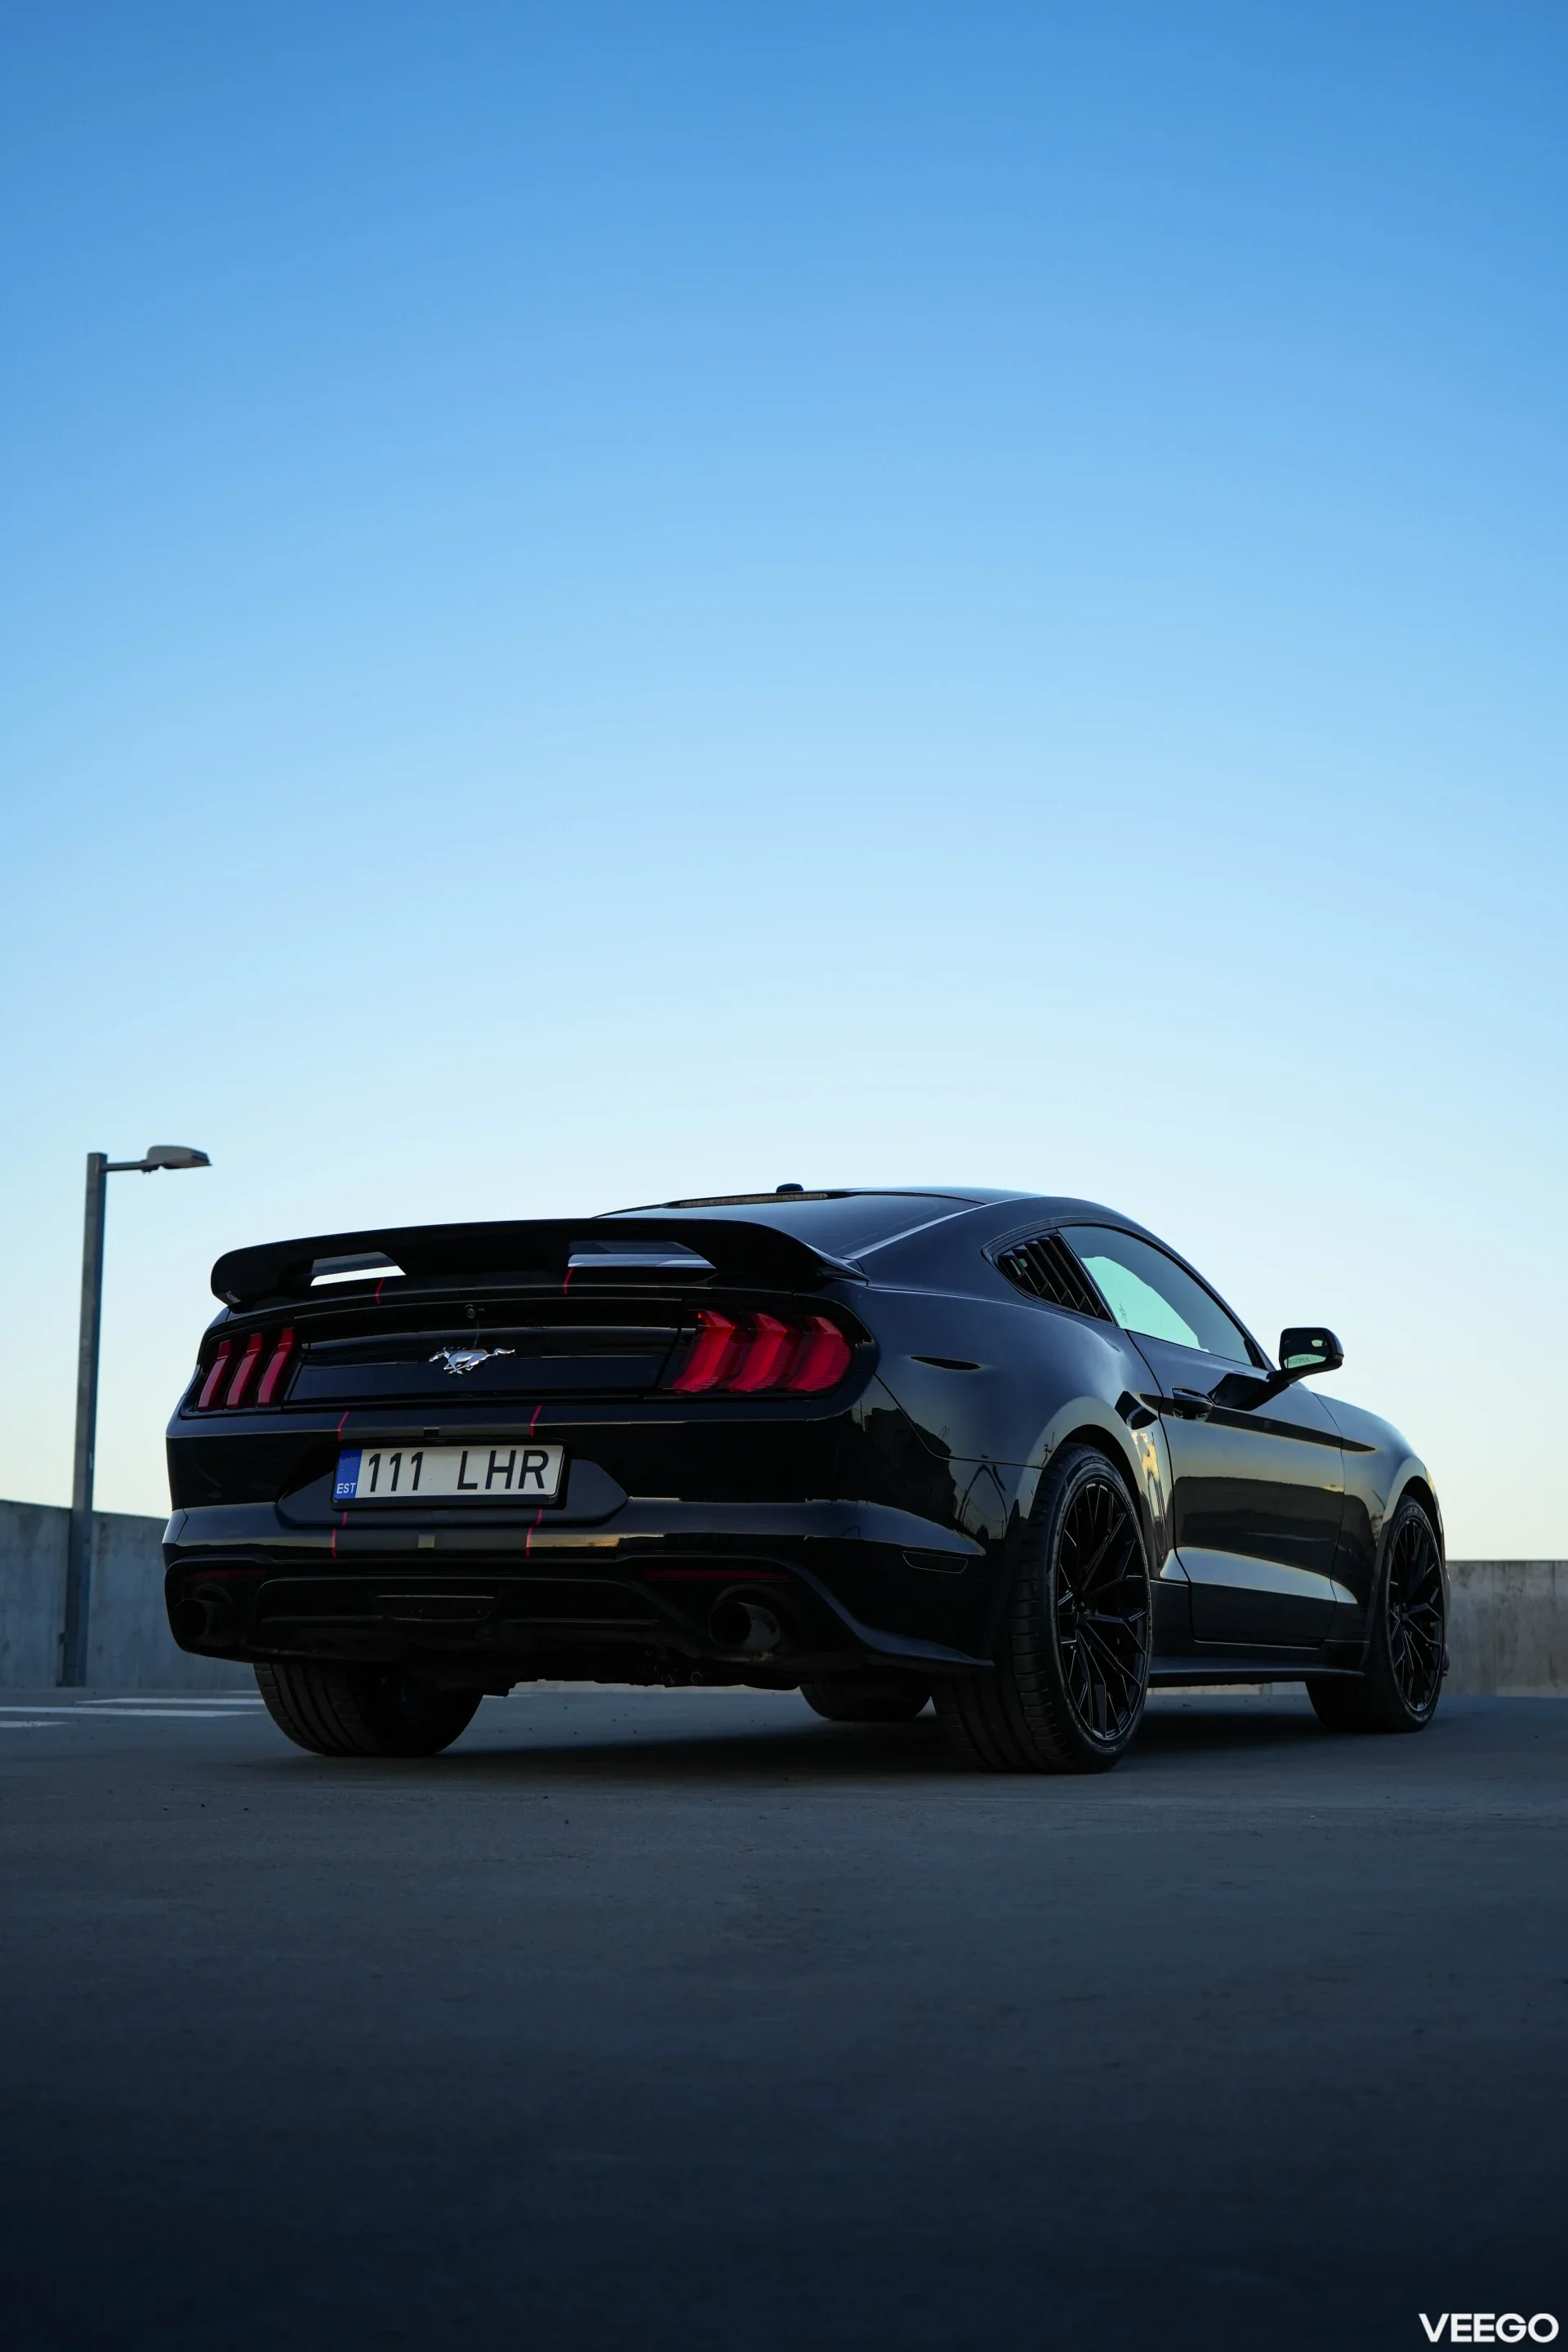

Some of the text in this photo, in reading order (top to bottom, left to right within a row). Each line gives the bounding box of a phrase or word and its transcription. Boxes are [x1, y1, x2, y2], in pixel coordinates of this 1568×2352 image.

[368, 1450, 549, 1492] 111 LHR
[336, 1482, 357, 1494] EST
